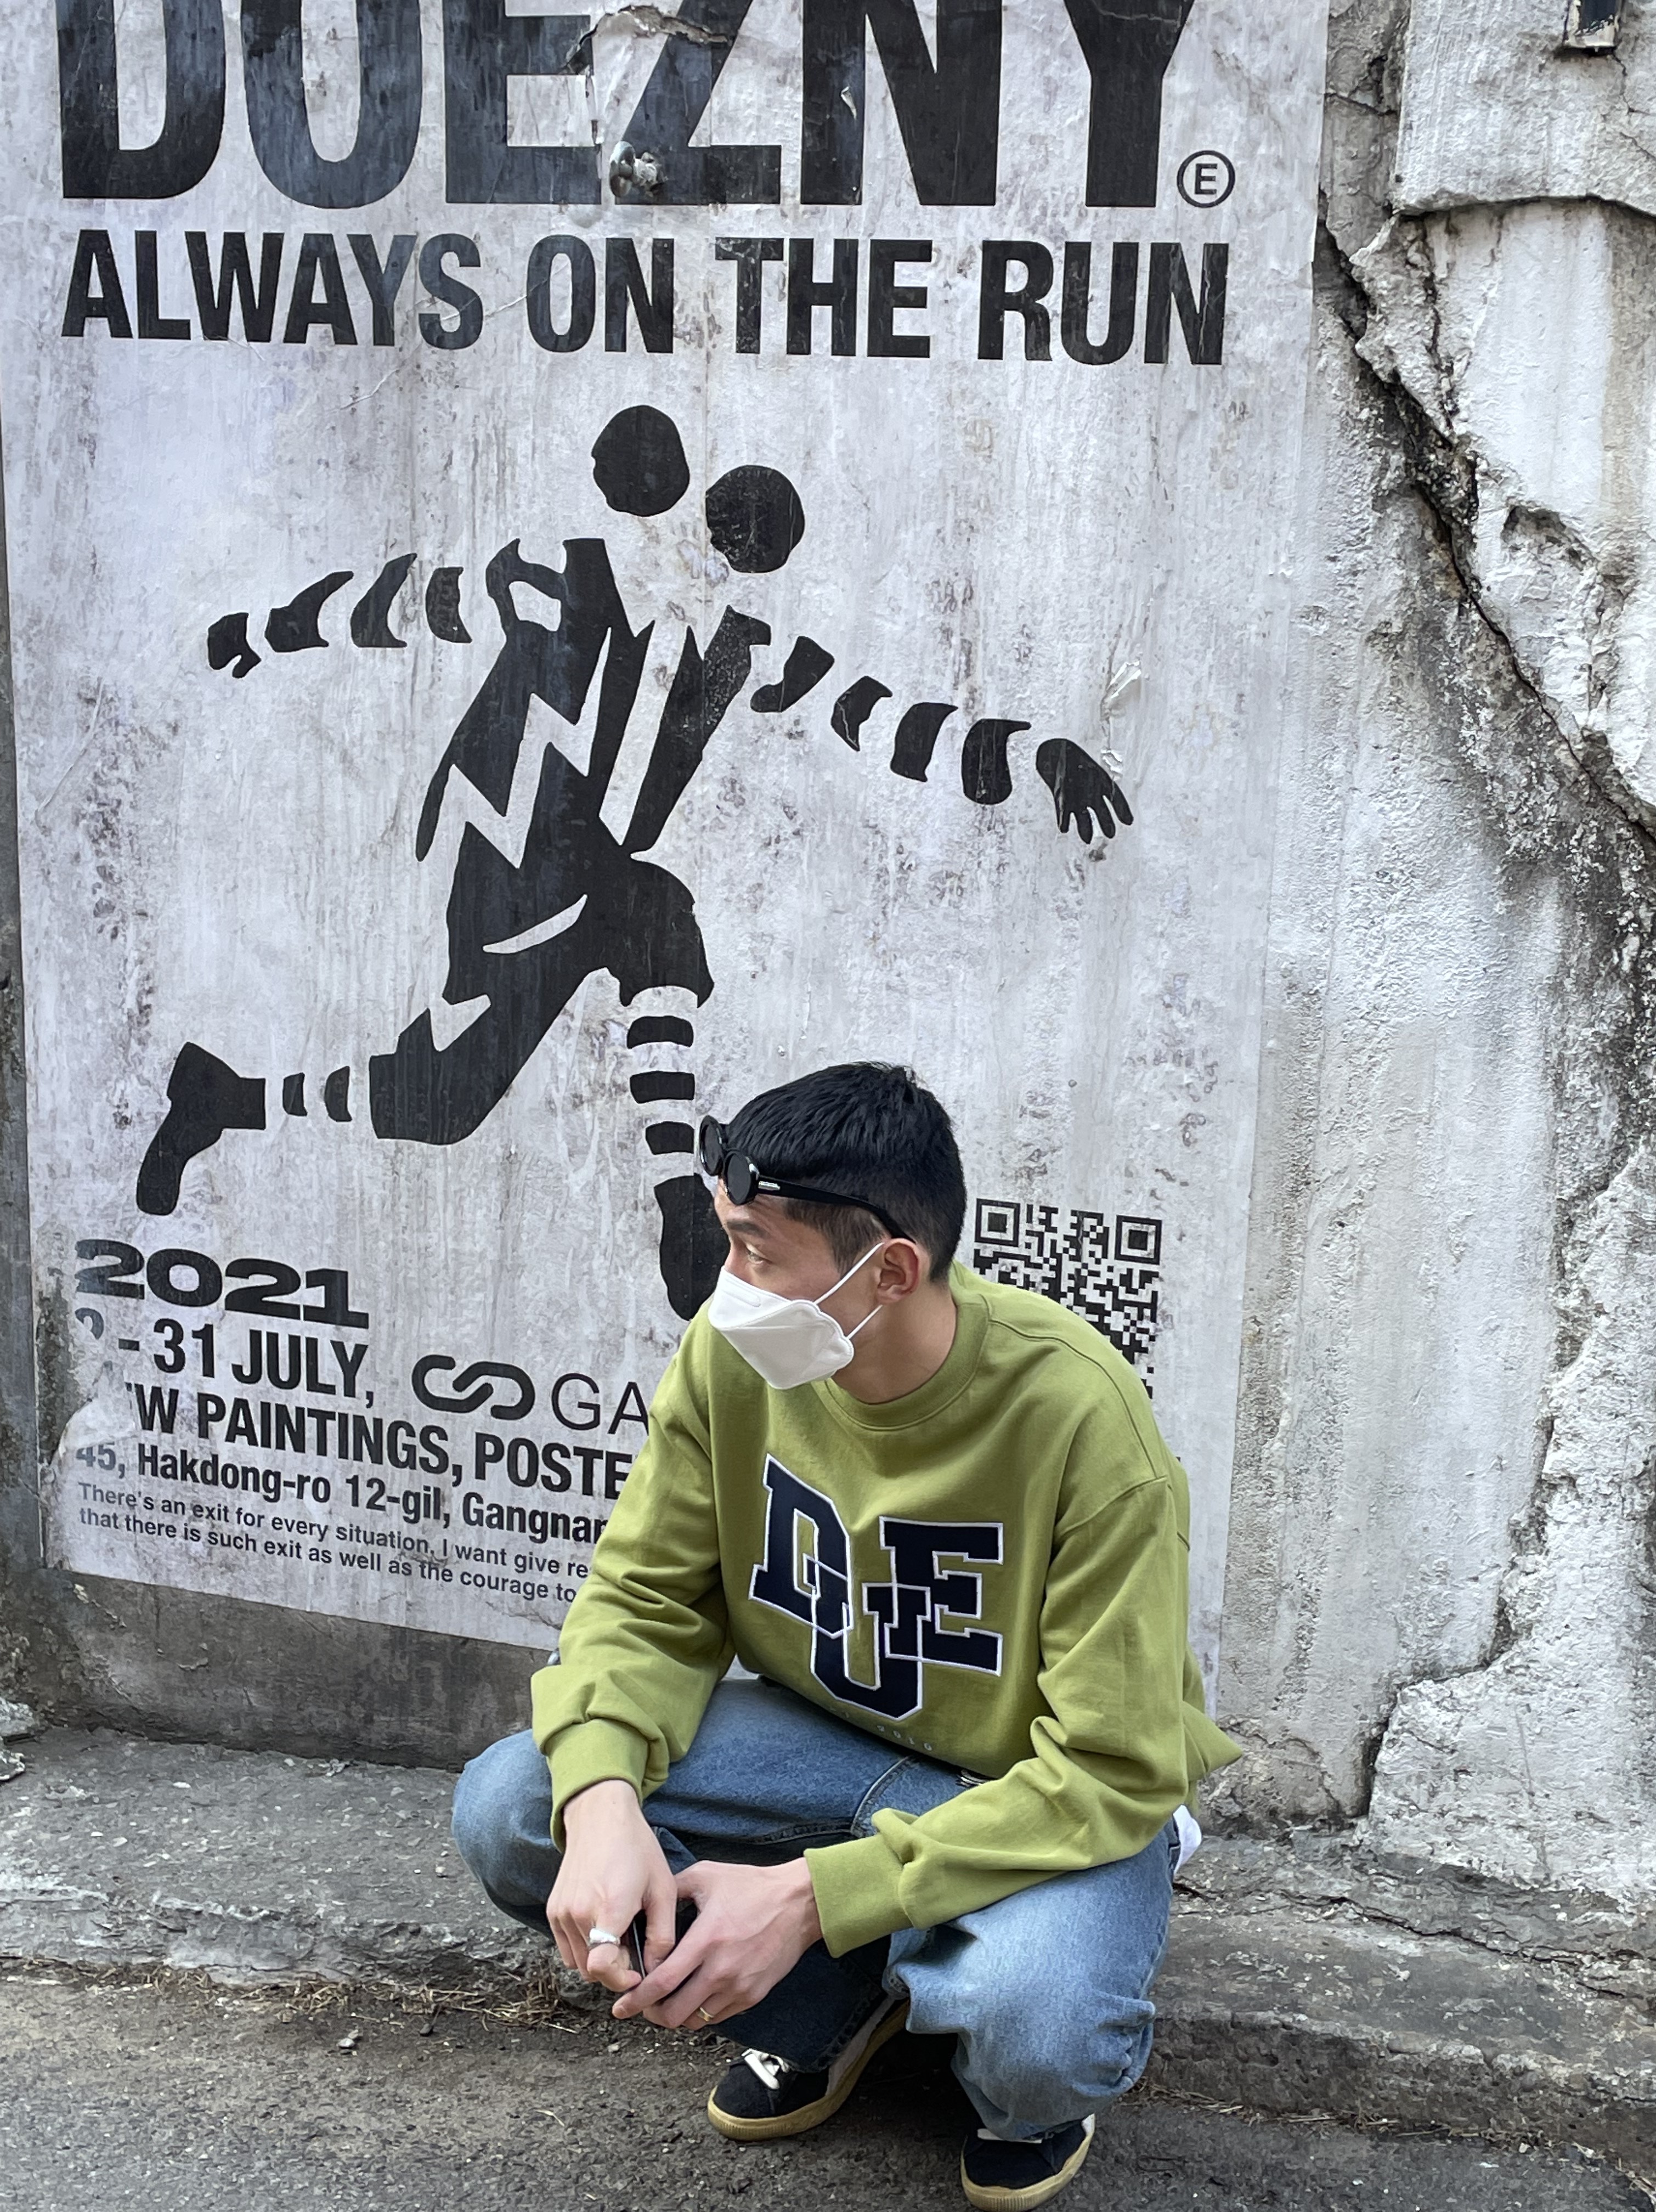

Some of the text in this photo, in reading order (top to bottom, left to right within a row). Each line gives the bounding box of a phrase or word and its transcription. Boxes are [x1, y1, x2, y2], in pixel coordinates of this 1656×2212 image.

[56, 0, 1194, 208] DUEZNY
[61, 229, 1229, 366] ALWAYS ON THE RUN
[75, 1239, 369, 1329] 2021
[154, 1318, 214, 1378] 31
[231, 1329, 374, 1408] JULY,
[138, 1443, 331, 1503] Hakdong-ro
[345, 1474, 450, 1529] 12-gil,
[197, 1392, 462, 1487] PAINTINGS,
[474, 1432, 633, 1500] POSTE
[78, 1482, 154, 1510] There's
[161, 1499, 185, 1516] an
[192, 1503, 229, 1523] exit
[236, 1507, 265, 1528] for
[271, 1516, 329, 1542] every
[442, 1539, 448, 1557] I
[455, 1544, 507, 1566] want
[514, 1551, 560, 1574] give
[80, 1508, 119, 1530] that
[126, 1515, 177, 1538] there
[184, 1523, 201, 1542] is
[207, 1530, 257, 1552] such
[264, 1539, 302, 1560] exit
[308, 1548, 332, 1564] as
[340, 1551, 381, 1571] well
[388, 1559, 412, 1576] as
[419, 1561, 453, 1582] the
[460, 1571, 549, 1601] courage
